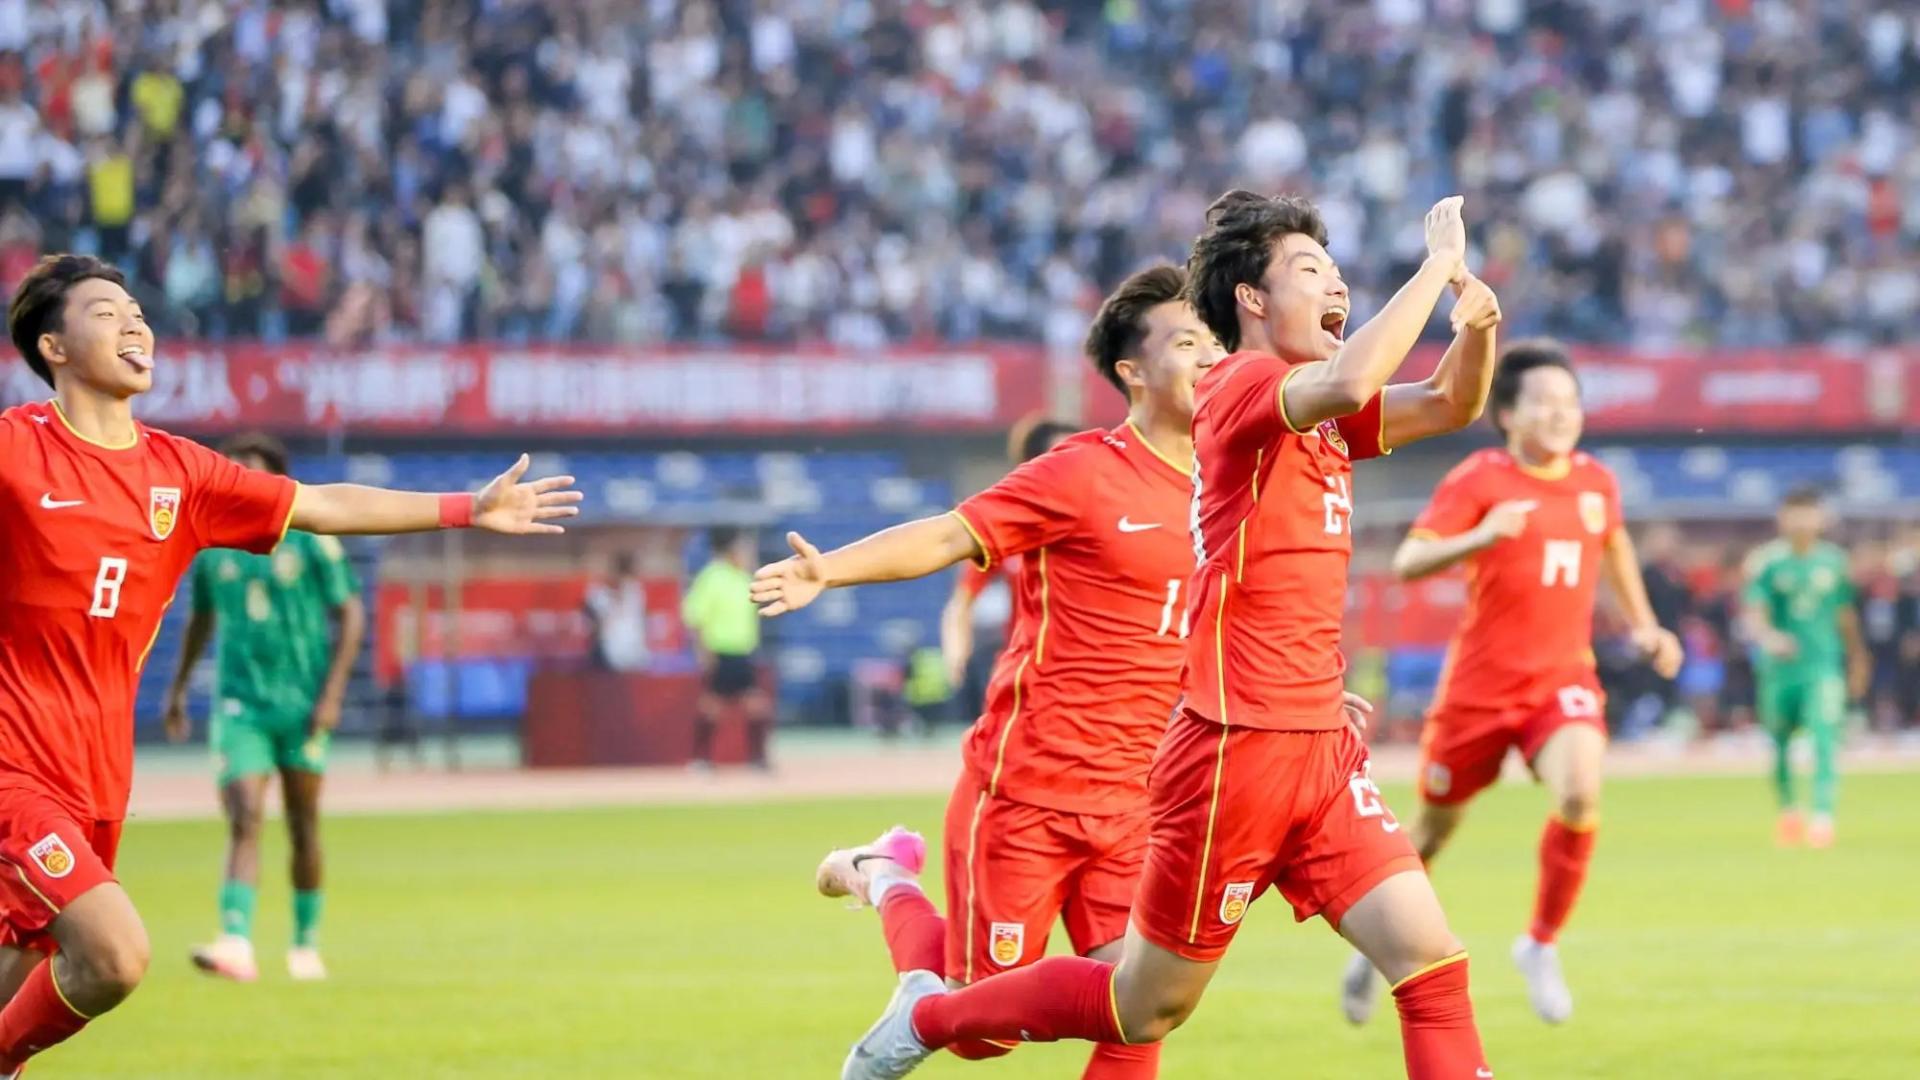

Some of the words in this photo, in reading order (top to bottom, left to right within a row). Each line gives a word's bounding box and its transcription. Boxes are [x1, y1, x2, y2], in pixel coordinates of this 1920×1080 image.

[1323, 474, 1352, 535] 2
[89, 556, 127, 618] 8
[1349, 760, 1384, 817] 2
